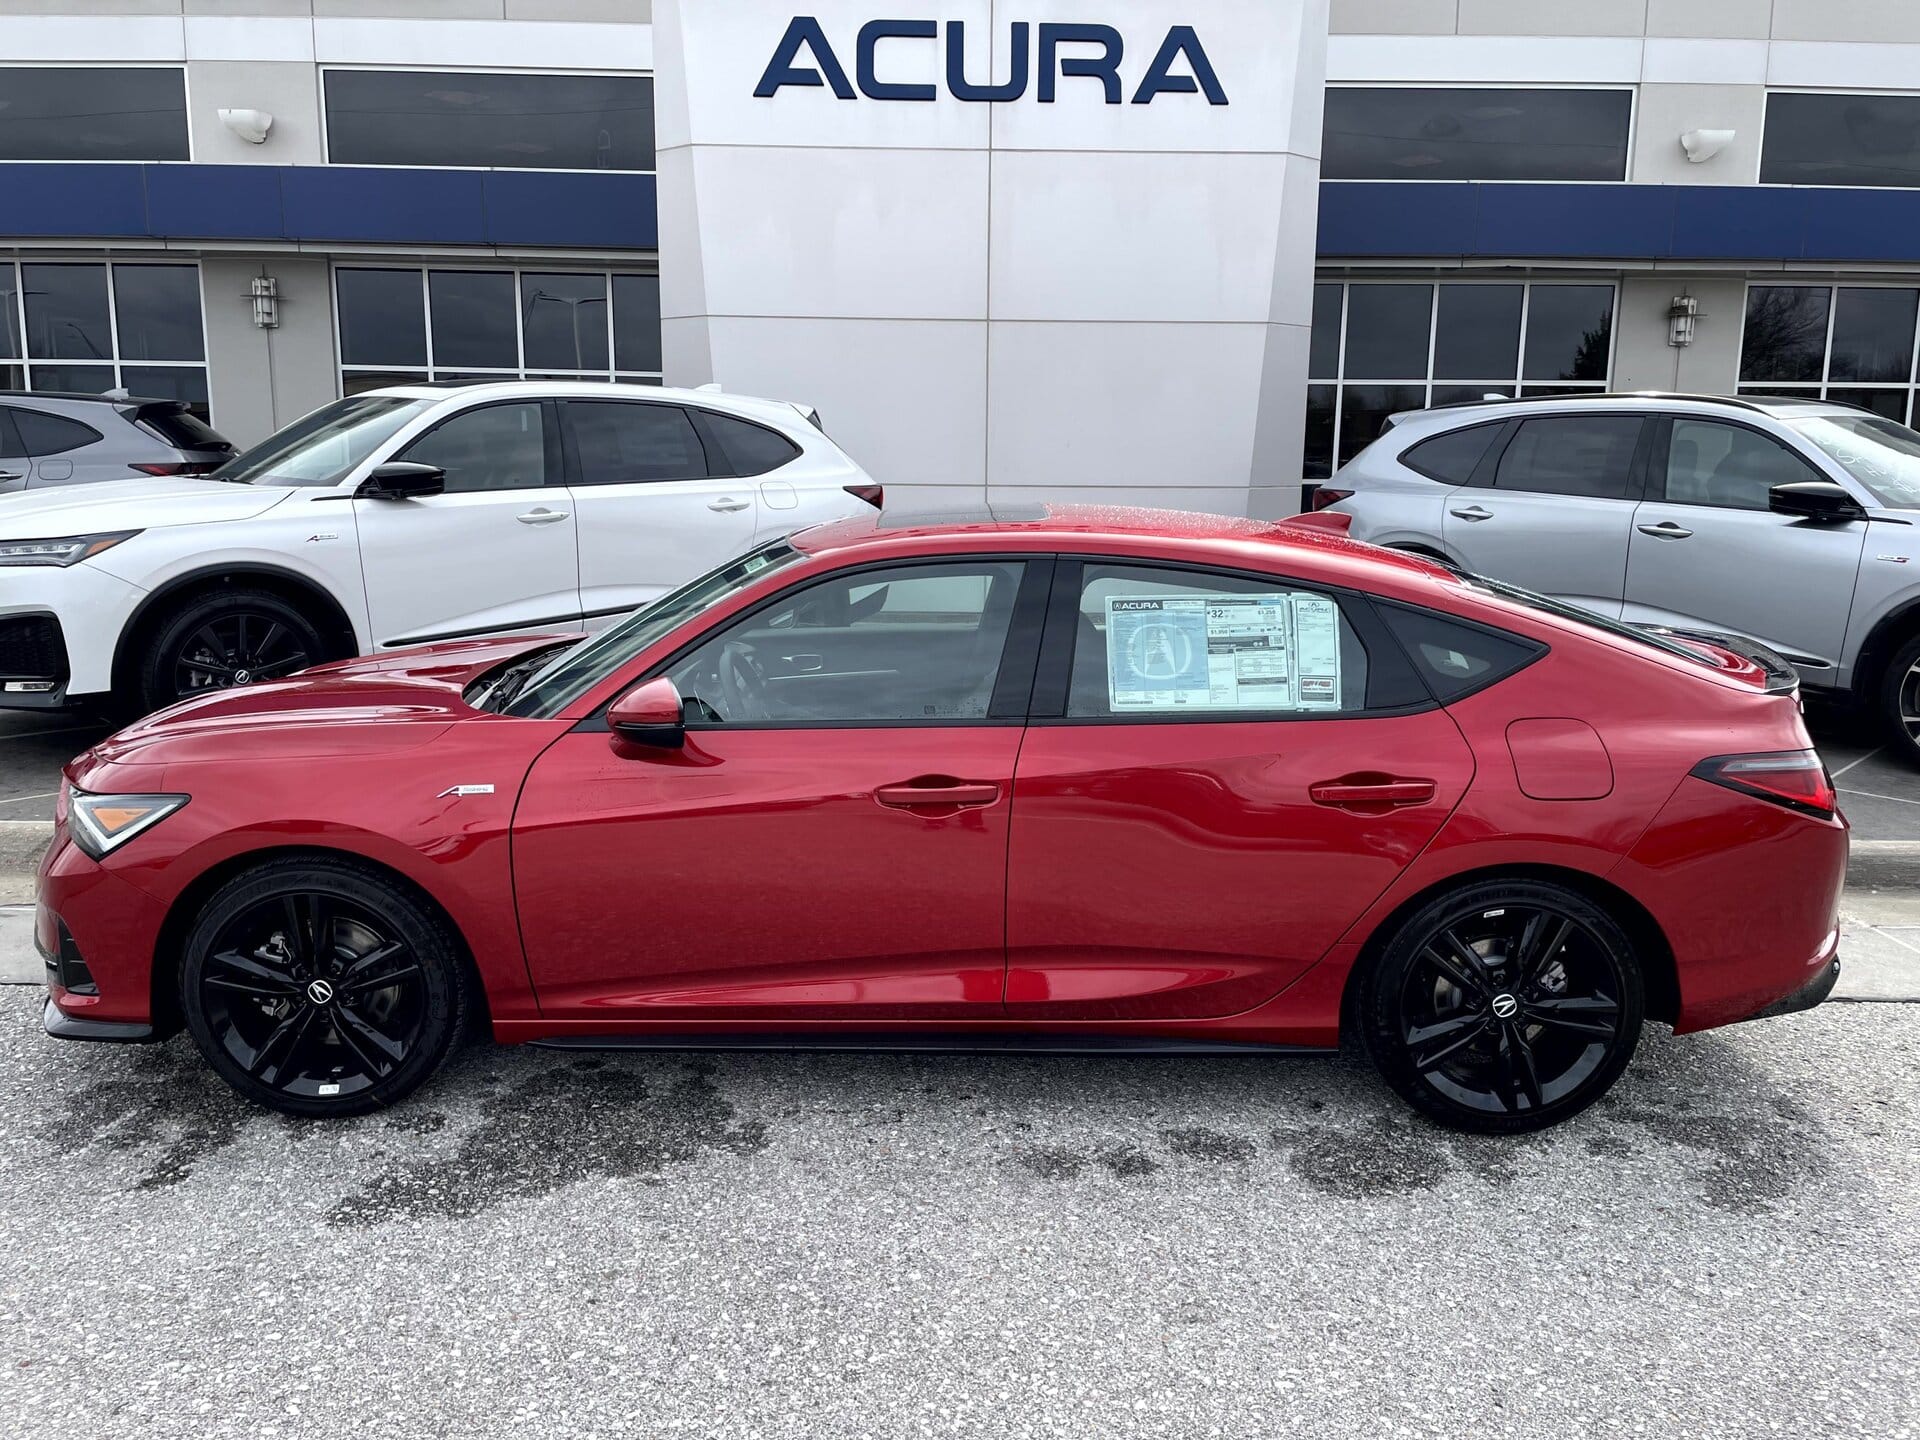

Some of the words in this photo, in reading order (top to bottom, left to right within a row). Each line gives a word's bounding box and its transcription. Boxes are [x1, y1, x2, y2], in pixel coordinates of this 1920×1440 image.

[753, 16, 1229, 105] ACURA
[1121, 602, 1160, 610] ACURA
[1211, 609, 1224, 618] 32
